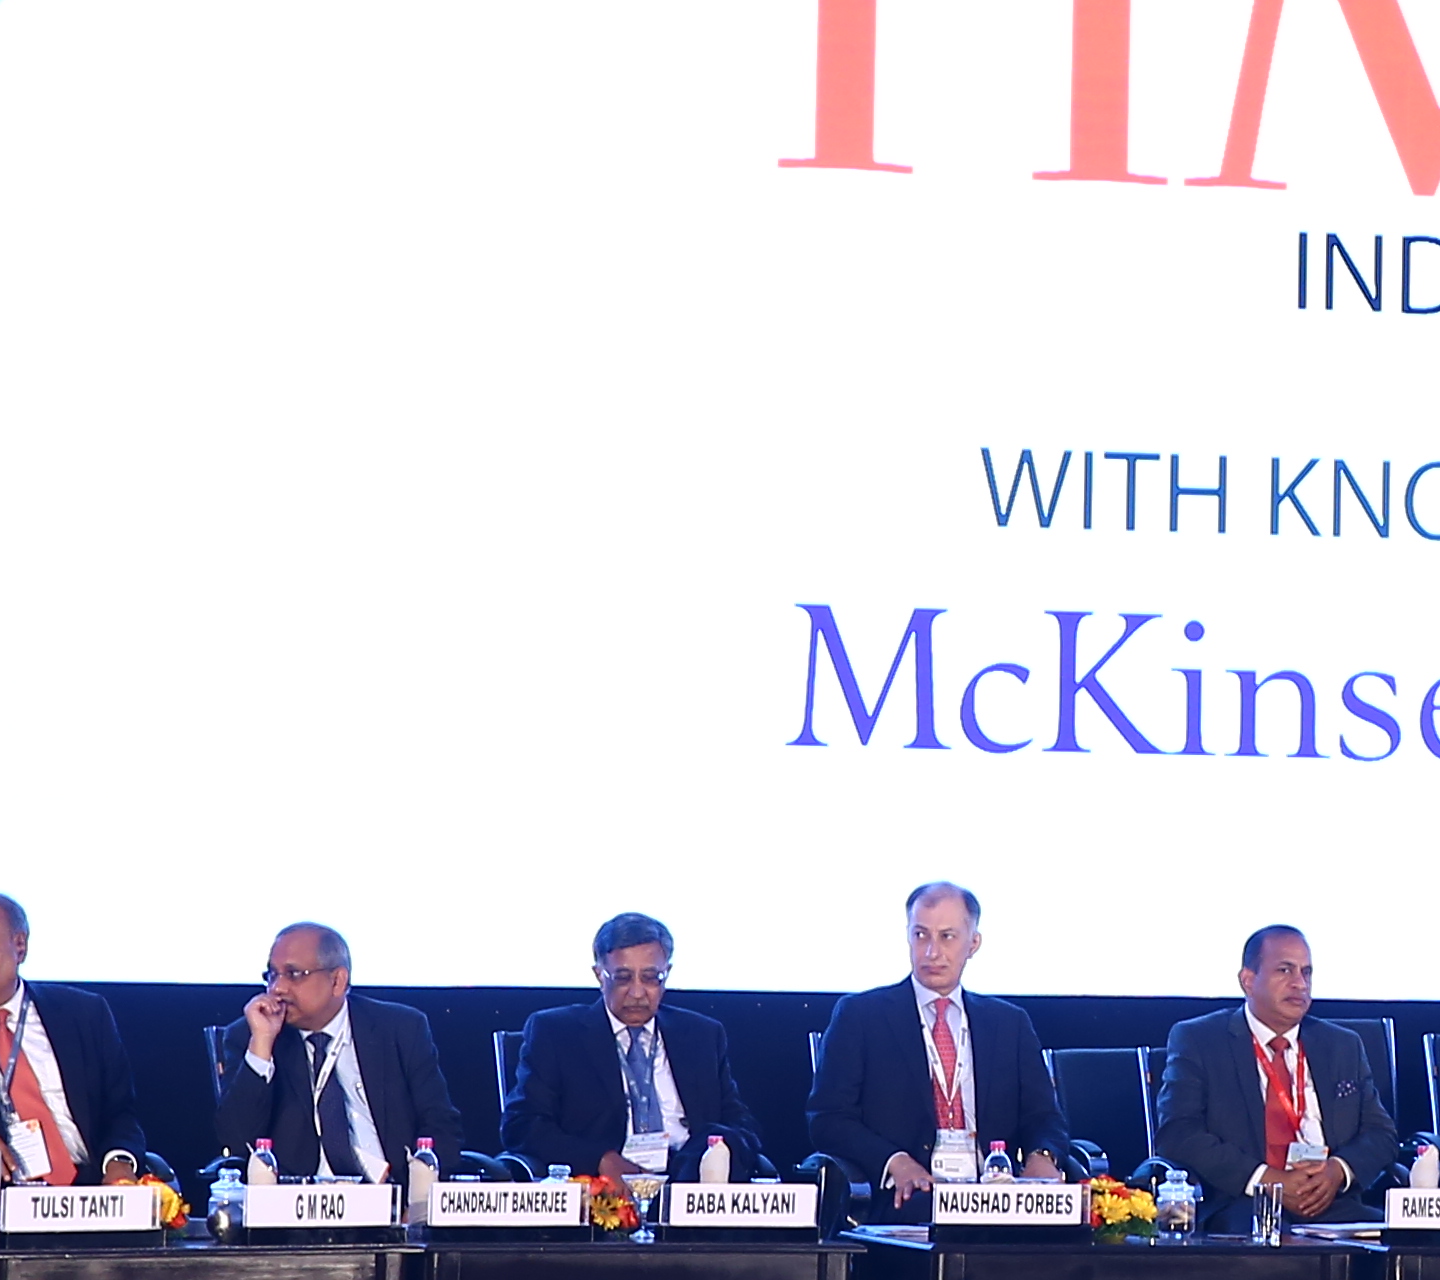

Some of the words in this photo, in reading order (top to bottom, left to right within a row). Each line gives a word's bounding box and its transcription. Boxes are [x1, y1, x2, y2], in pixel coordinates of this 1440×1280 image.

[981, 447, 1227, 534] WITH
[32, 1196, 74, 1218] TULSI
[79, 1195, 124, 1218] TANTI
[295, 1194, 304, 1220] G
[307, 1194, 318, 1220] M
[321, 1194, 345, 1220] RAO
[441, 1191, 509, 1214] CHANDRAJIT
[511, 1191, 567, 1213] BANERJEE
[686, 1192, 726, 1214] BABA
[730, 1192, 796, 1214] KALYANI
[939, 1192, 1010, 1214] NAUSHAD
[1015, 1192, 1073, 1215] FORBES
